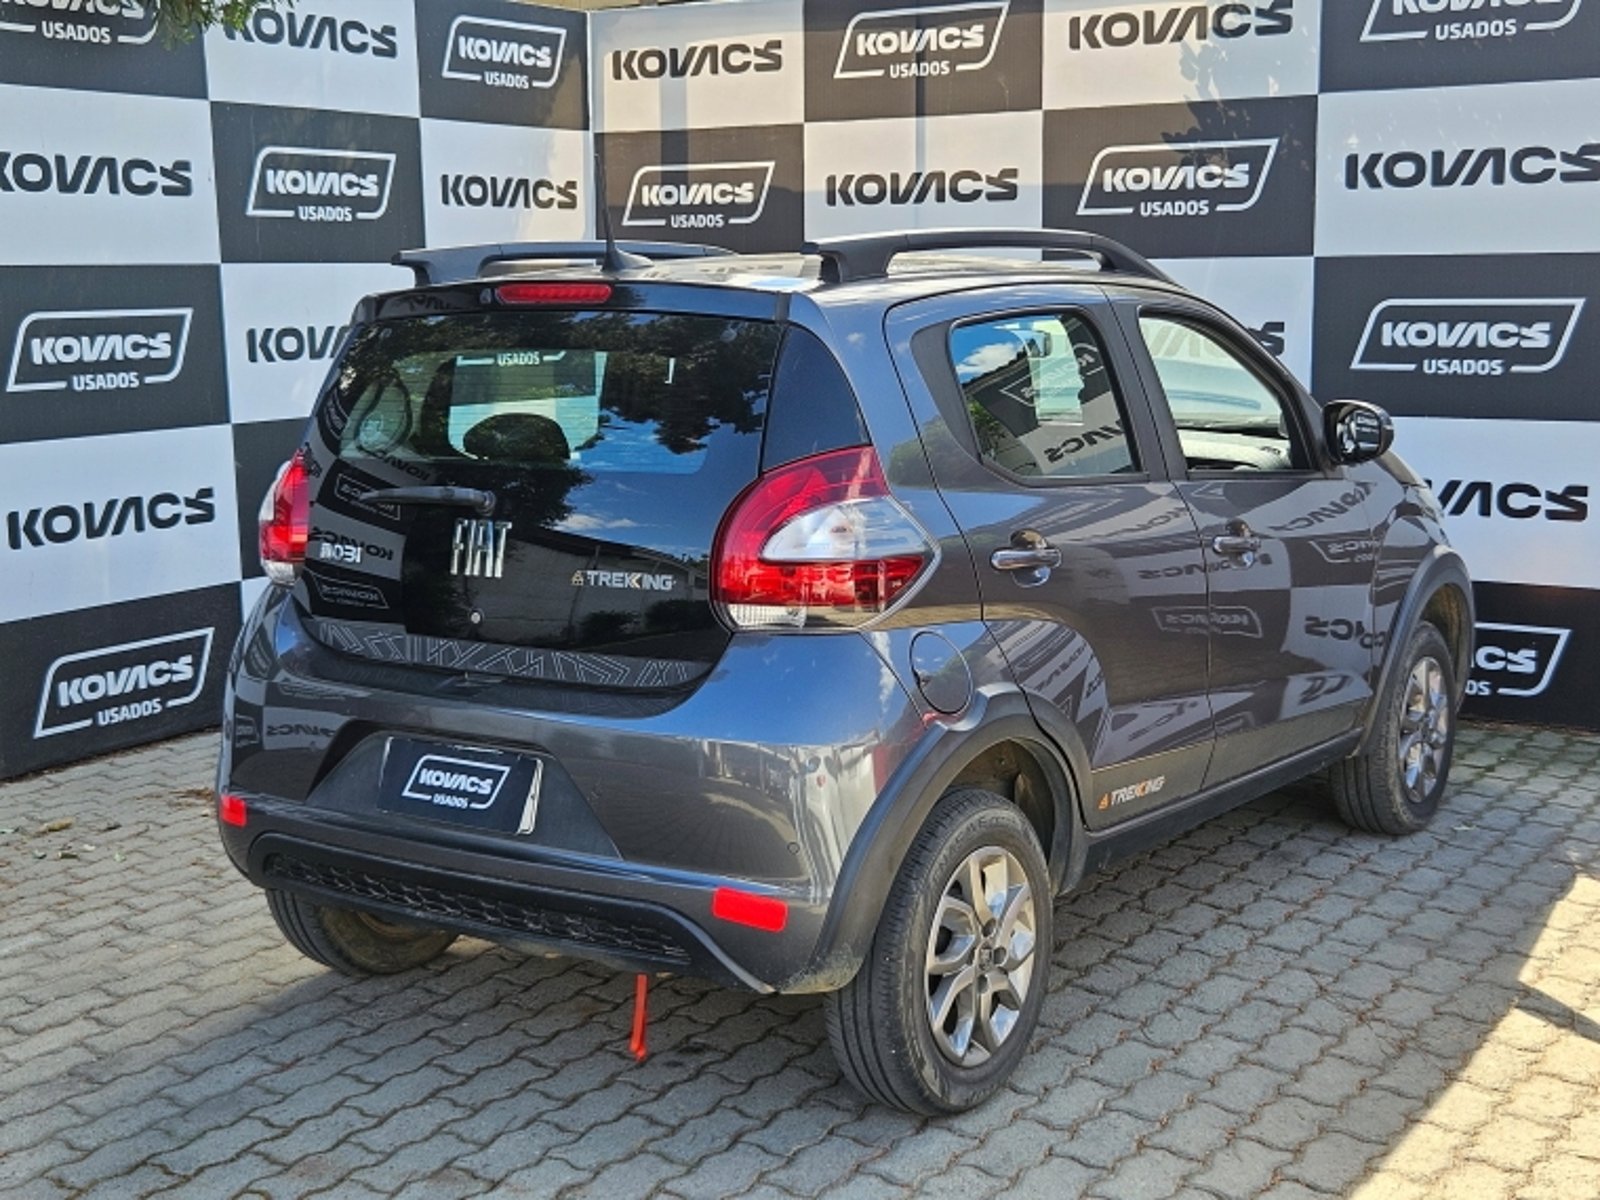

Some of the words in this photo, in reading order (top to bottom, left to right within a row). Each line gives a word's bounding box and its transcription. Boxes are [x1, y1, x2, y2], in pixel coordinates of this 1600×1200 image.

[42, 21, 111, 44] USADOS
[1068, 0, 1293, 51] KOVACS
[1435, 19, 1517, 41] USADOS
[458, 36, 552, 68] KOVACS
[856, 24, 985, 57] KOVACS
[612, 40, 783, 81] KOVACS
[890, 61, 950, 78] USADOS
[484, 70, 529, 89] USADOS
[1102, 162, 1250, 193] KOVACS
[1345, 142, 1600, 190] KOVACS
[266, 169, 379, 197] KOVACS
[442, 174, 578, 209] KOVACS
[641, 182, 755, 207] KOVACS
[826, 168, 1018, 207] KOVACS
[298, 205, 353, 222] USADOS
[670, 214, 724, 229] USADOS
[1140, 200, 1210, 218] USADOS
[32, 332, 171, 365] KOVACS
[1381, 321, 1551, 349] KOVACS
[497, 351, 540, 366] USADOS
[1422, 358, 1503, 376] USADOS
[73, 372, 140, 391] USADOS
[7, 487, 216, 550] KOVACS
[320, 543, 362, 564] MOBI
[451, 519, 513, 578] FIAT
[587, 570, 674, 590] TREKKING
[57, 655, 194, 708] KOVACS
[97, 698, 162, 727] USADOS
[419, 768, 493, 794] KOVACS
